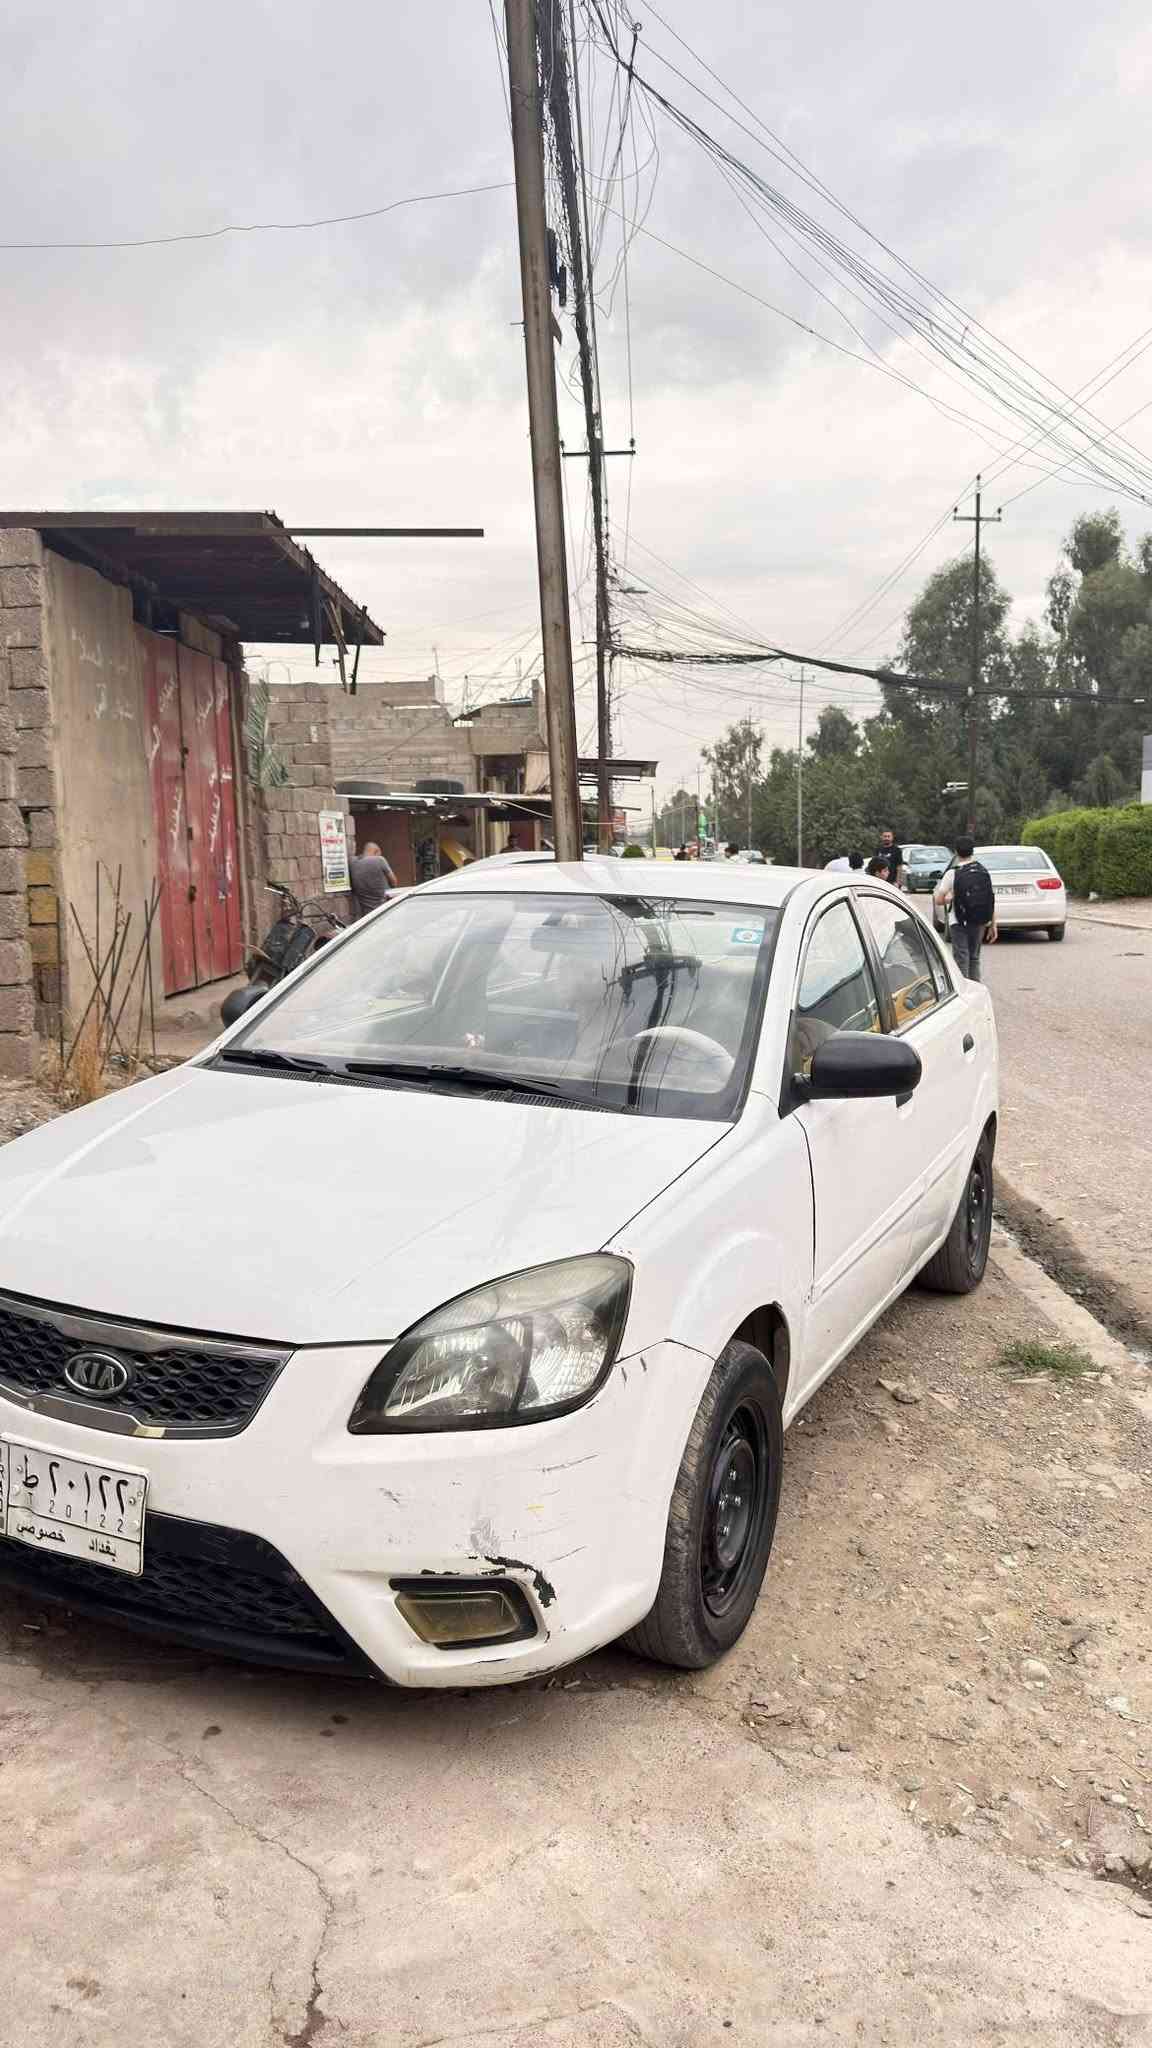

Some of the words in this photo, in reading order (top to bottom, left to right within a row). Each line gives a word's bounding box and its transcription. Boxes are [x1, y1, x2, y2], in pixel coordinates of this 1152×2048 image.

[73, 1359, 115, 1389] KIA
[49, 1499, 124, 1534] 20122
[16, 1522, 66, 1544] خصوصي
[88, 1538, 118, 1562] بغداد
